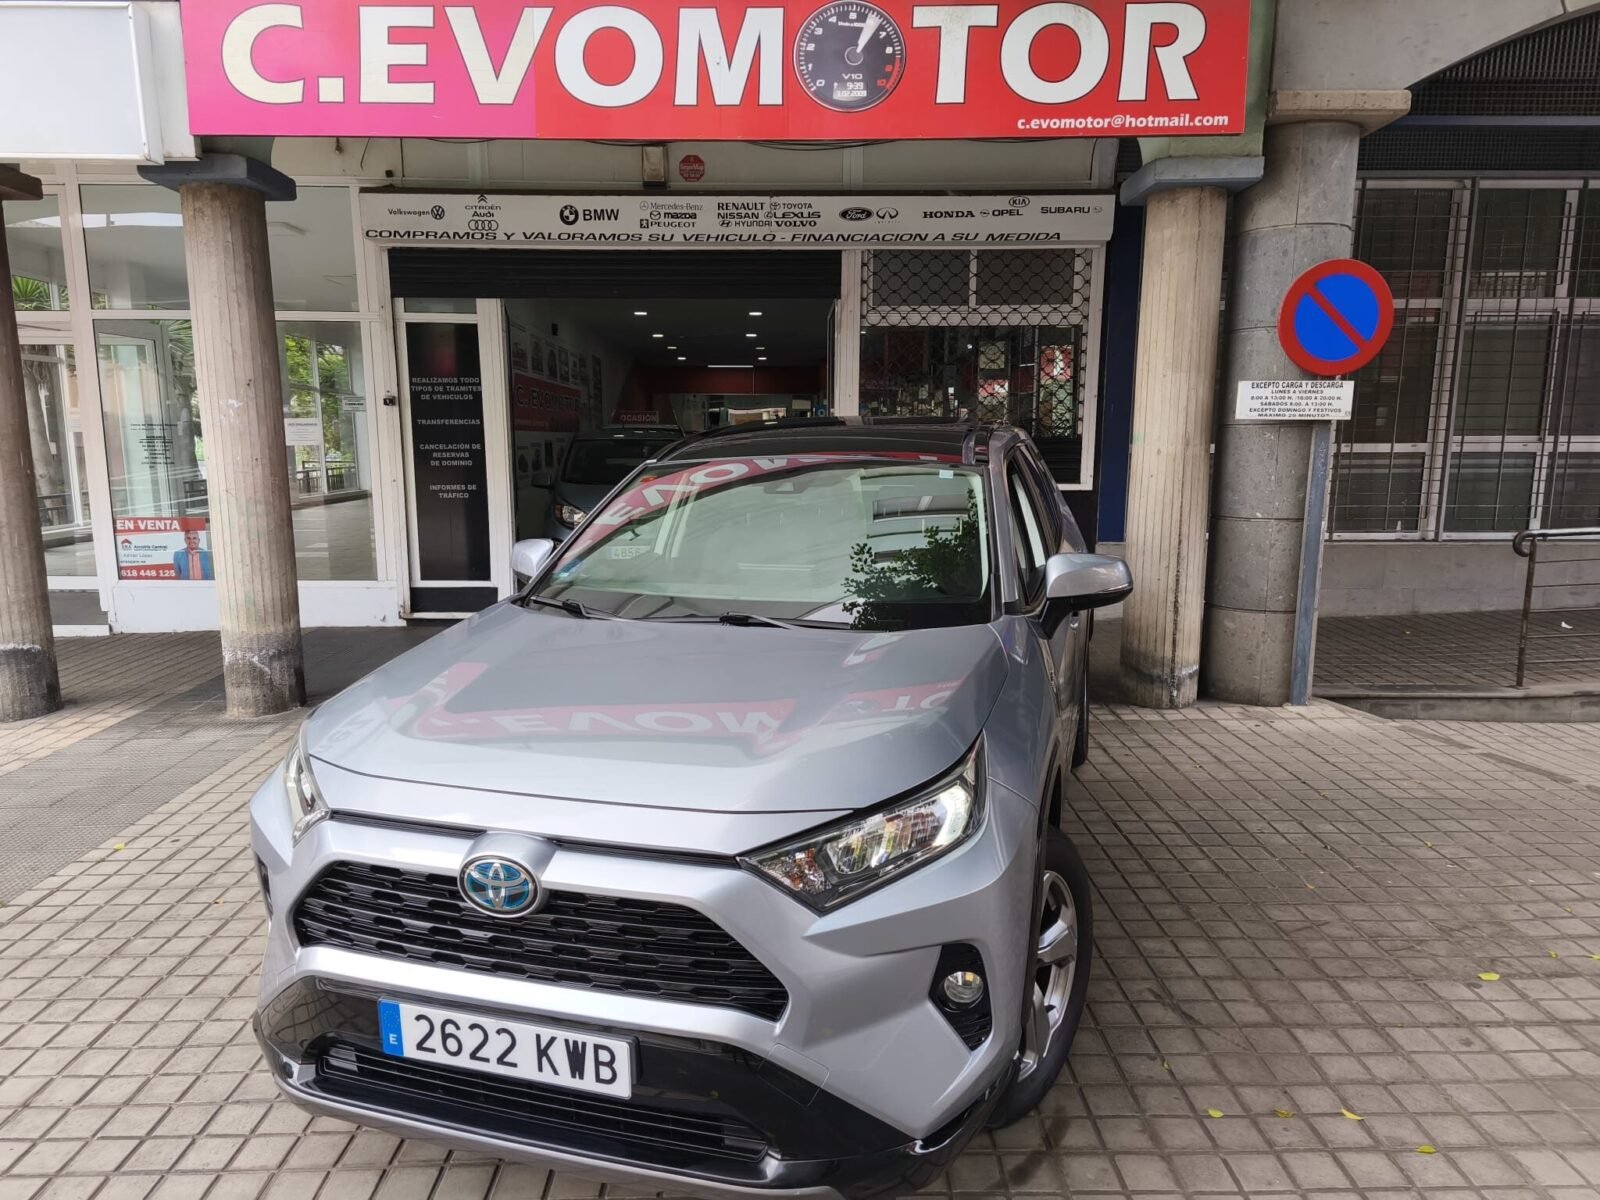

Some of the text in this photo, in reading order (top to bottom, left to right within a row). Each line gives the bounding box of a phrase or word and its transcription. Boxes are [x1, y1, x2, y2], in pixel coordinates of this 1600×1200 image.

[1017, 113, 1229, 129] c.evomotor@hotmail.com
[1011, 197, 1028, 206] KIA
[650, 202, 703, 212] Mercedes-Benz
[717, 202, 766, 212] RENAULT
[1040, 206, 1090, 214] SUBARU
[388, 208, 430, 218] Volkswagen
[583, 208, 620, 222] BMW
[717, 212, 760, 220] NISSAN
[774, 212, 821, 220] LEXUS
[923, 210, 976, 219] HONDA
[992, 208, 1024, 217] OPEL
[650, 220, 696, 228] PEUGEOT
[365, 229, 498, 240] COMPRAMOS
[503, 231, 517, 241] Y
[523, 232, 643, 242] VALORAMOS
[648, 233, 676, 242] SU
[681, 232, 776, 242] VEHICULO
[791, 232, 930, 242] FINANCIACION
[932, 233, 947, 242] A
[951, 232, 980, 242] SU
[986, 232, 1062, 242] MEDIDA
[116, 520, 180, 530] EN VENTA
[389, 1013, 618, 1085] E 2622 KWB
